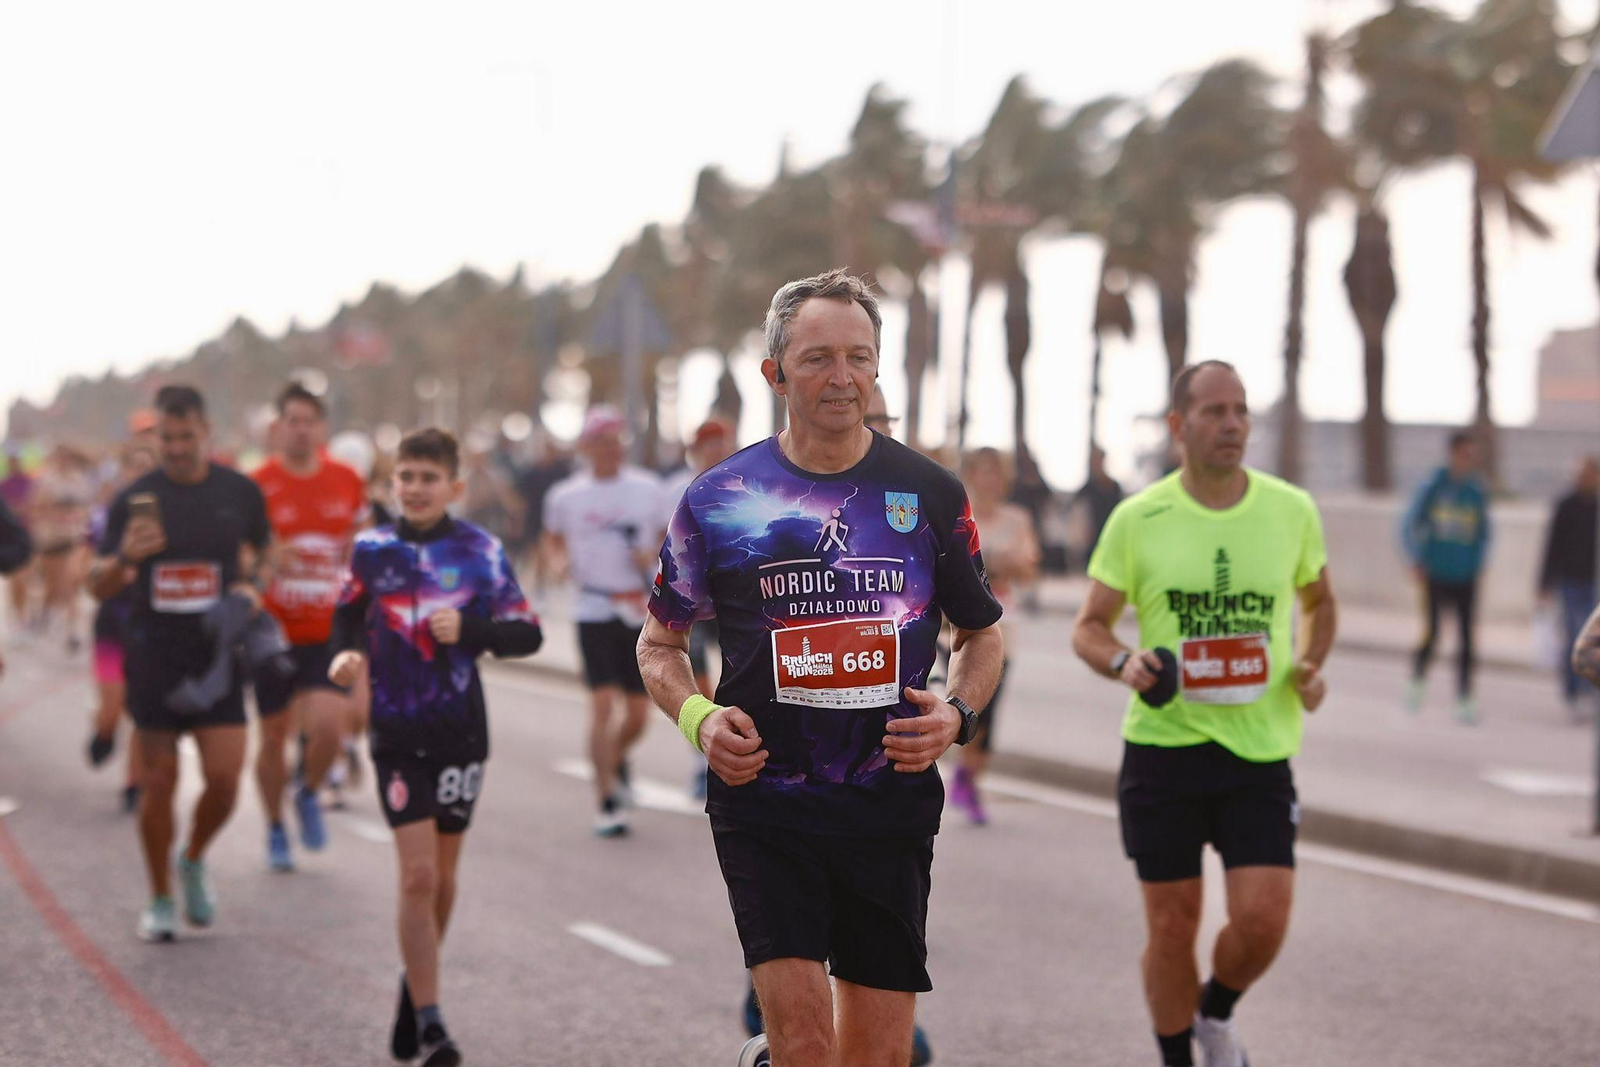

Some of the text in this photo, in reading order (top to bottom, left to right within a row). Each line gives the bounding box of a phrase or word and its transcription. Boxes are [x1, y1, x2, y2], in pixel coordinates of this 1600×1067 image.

[759, 569, 904, 600] NORDIC TEAM
[789, 599, 881, 616] DZIAŁDOWO
[1166, 588, 1274, 618] BRUNCH
[780, 652, 833, 667] BRUNCH
[842, 649, 885, 673] 668
[1229, 655, 1264, 677] 565
[787, 664, 813, 679] RUN
